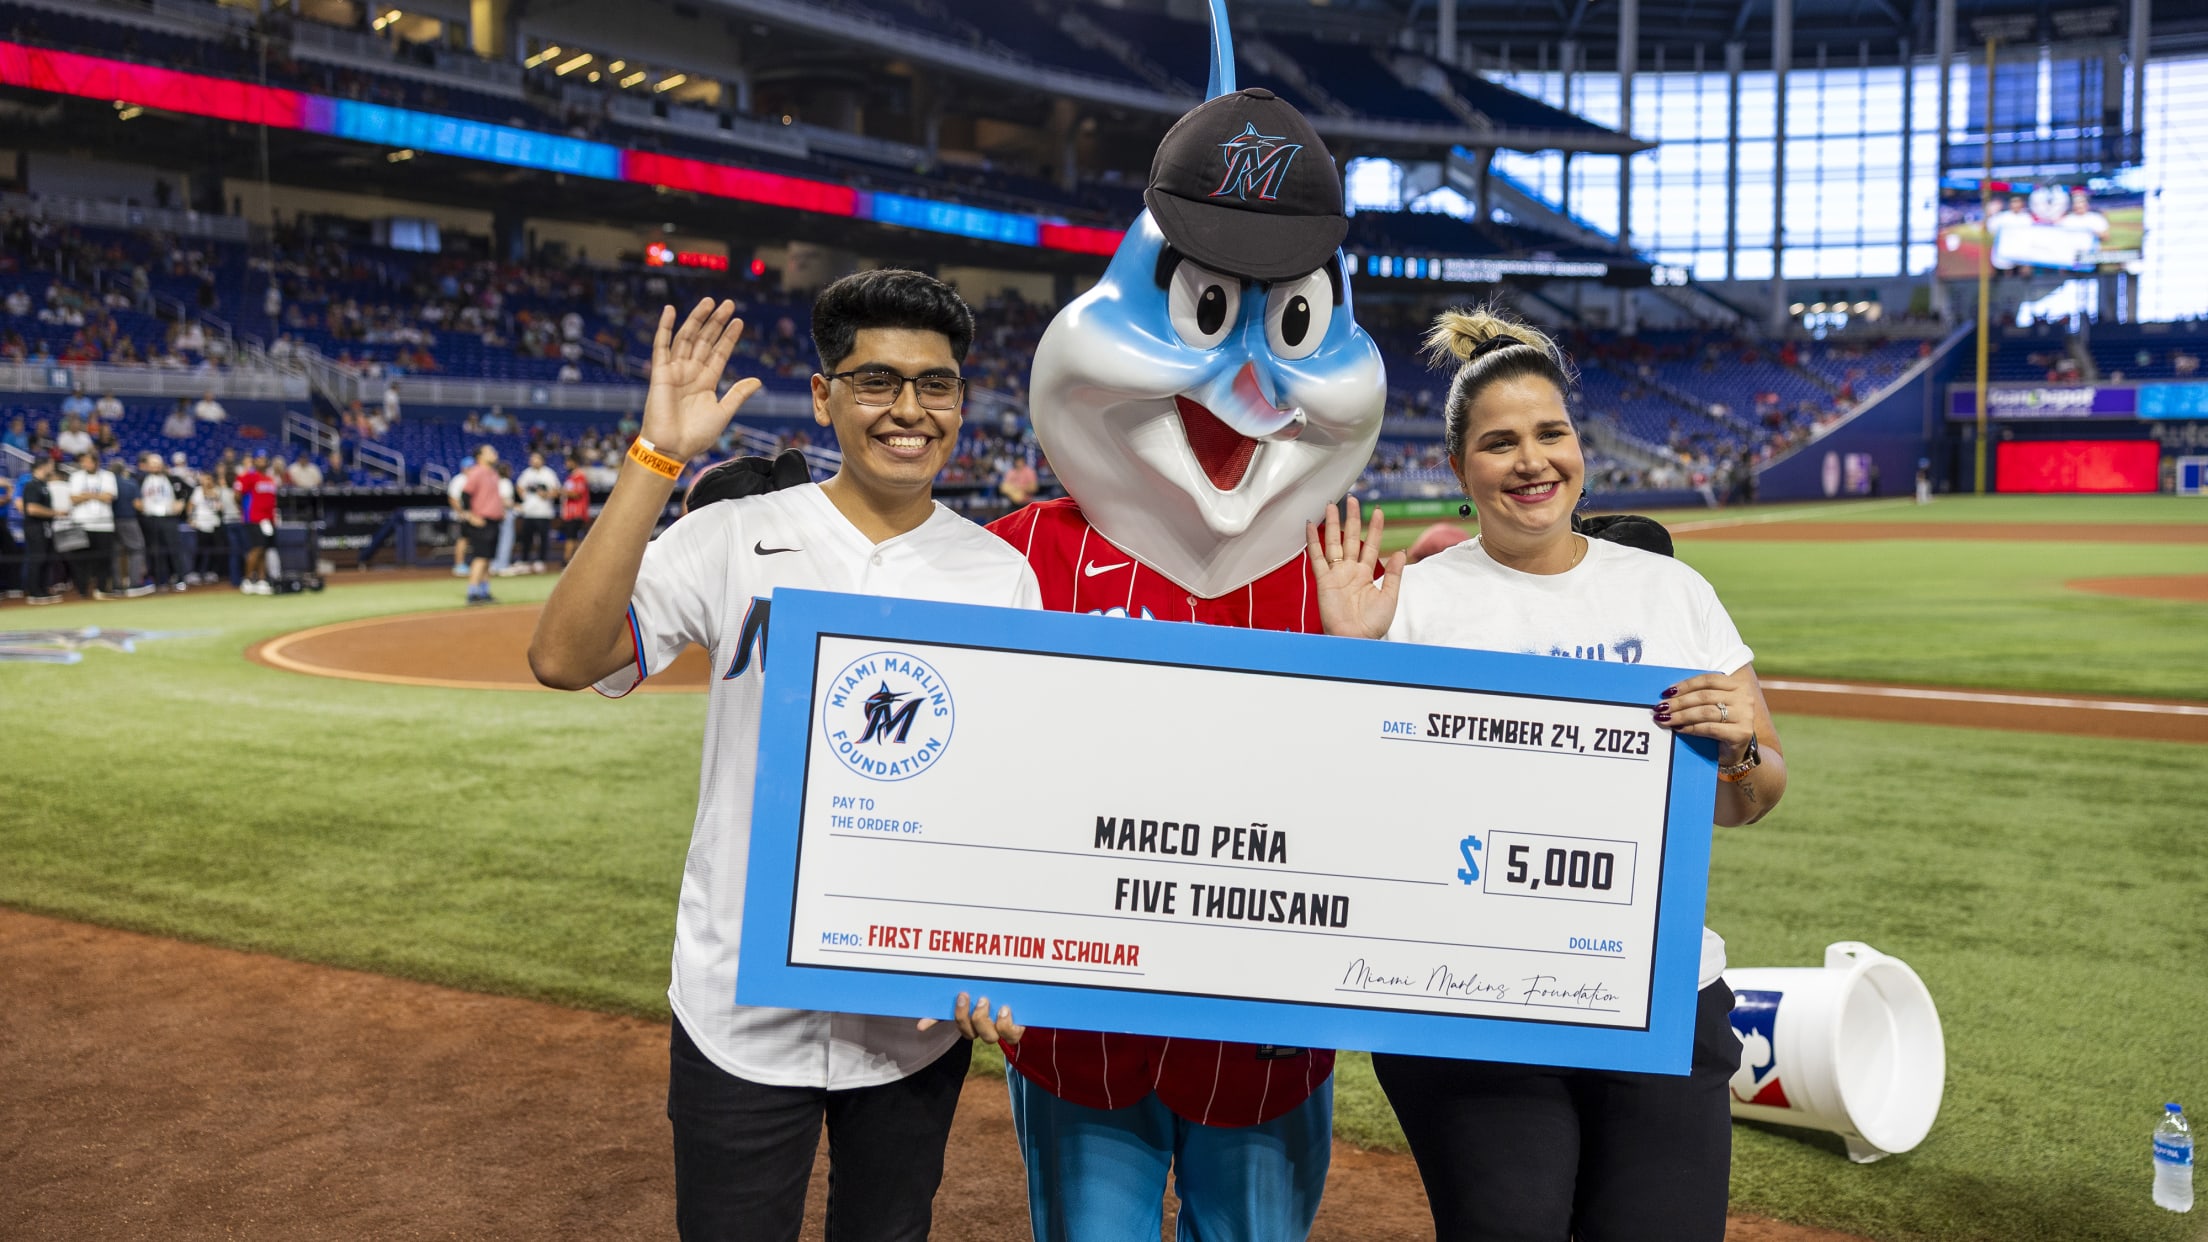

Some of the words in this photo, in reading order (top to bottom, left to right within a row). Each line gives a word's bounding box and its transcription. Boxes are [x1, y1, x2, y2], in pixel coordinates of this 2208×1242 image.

[832, 661, 877, 708] MIAMI
[885, 658, 948, 717] MARLINS
[833, 730, 941, 776] FOUNDATION
[1383, 720, 1417, 736] DATE:
[1427, 713, 1544, 747] SEPTEMBER
[1551, 723, 1585, 753] 24,
[1594, 727, 1650, 755] 2023
[831, 815, 854, 830] THE
[857, 817, 899, 834] ORDER
[902, 820, 923, 835] OF:
[832, 796, 856, 810] PAY
[859, 798, 874, 811] TO
[1094, 816, 1199, 857] MARCO
[1211, 822, 1288, 864] PEÑA
[1457, 834, 1483, 886] $
[1506, 844, 1615, 891] 5,000
[1115, 878, 1176, 915] FIVE
[1190, 884, 1350, 929] THOUSAND
[821, 931, 863, 947] MEMO:
[868, 925, 923, 952] FIRST
[929, 930, 1045, 960] GENERATION
[1052, 939, 1140, 967] SCHOLAR
[1569, 937, 1623, 953] DOLLARS
[1343, 958, 1416, 989] Miami
[1425, 965, 1510, 999] Marlins
[1521, 974, 1620, 1007] Foundation
